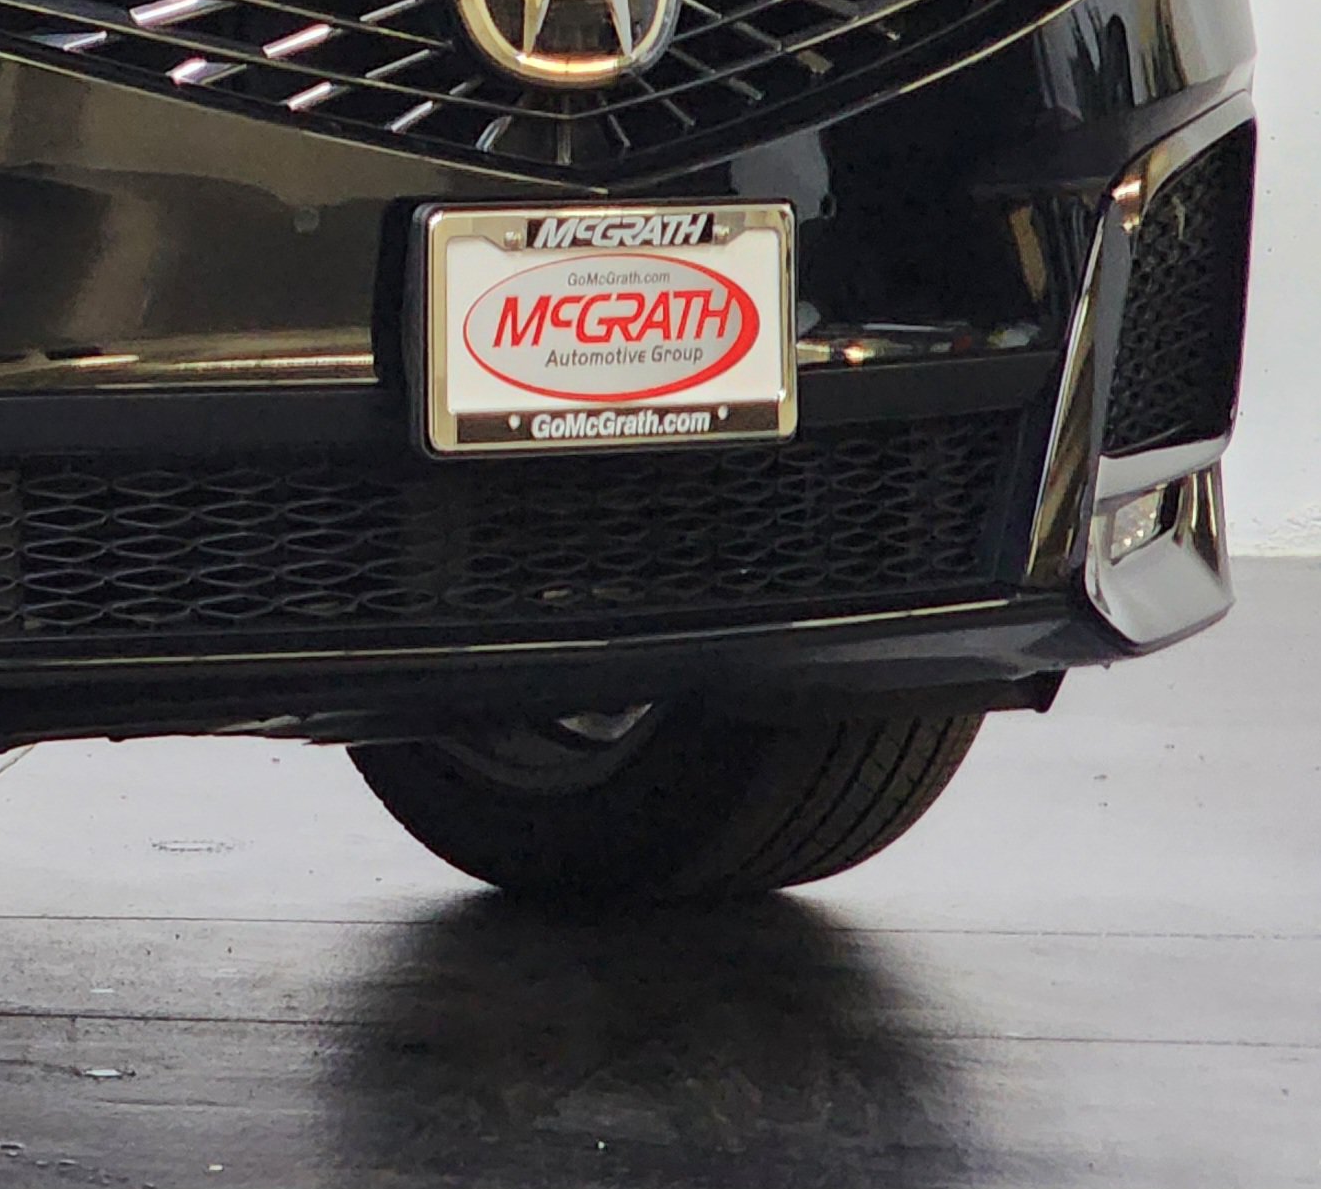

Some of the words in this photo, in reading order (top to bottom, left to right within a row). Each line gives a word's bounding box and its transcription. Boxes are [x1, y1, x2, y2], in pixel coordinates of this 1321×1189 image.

[567, 270, 671, 288] GoMcGrath.com
[544, 348, 646, 368] Automotive
[651, 345, 704, 365] Group
[530, 411, 711, 439] GoMcGrath.com
